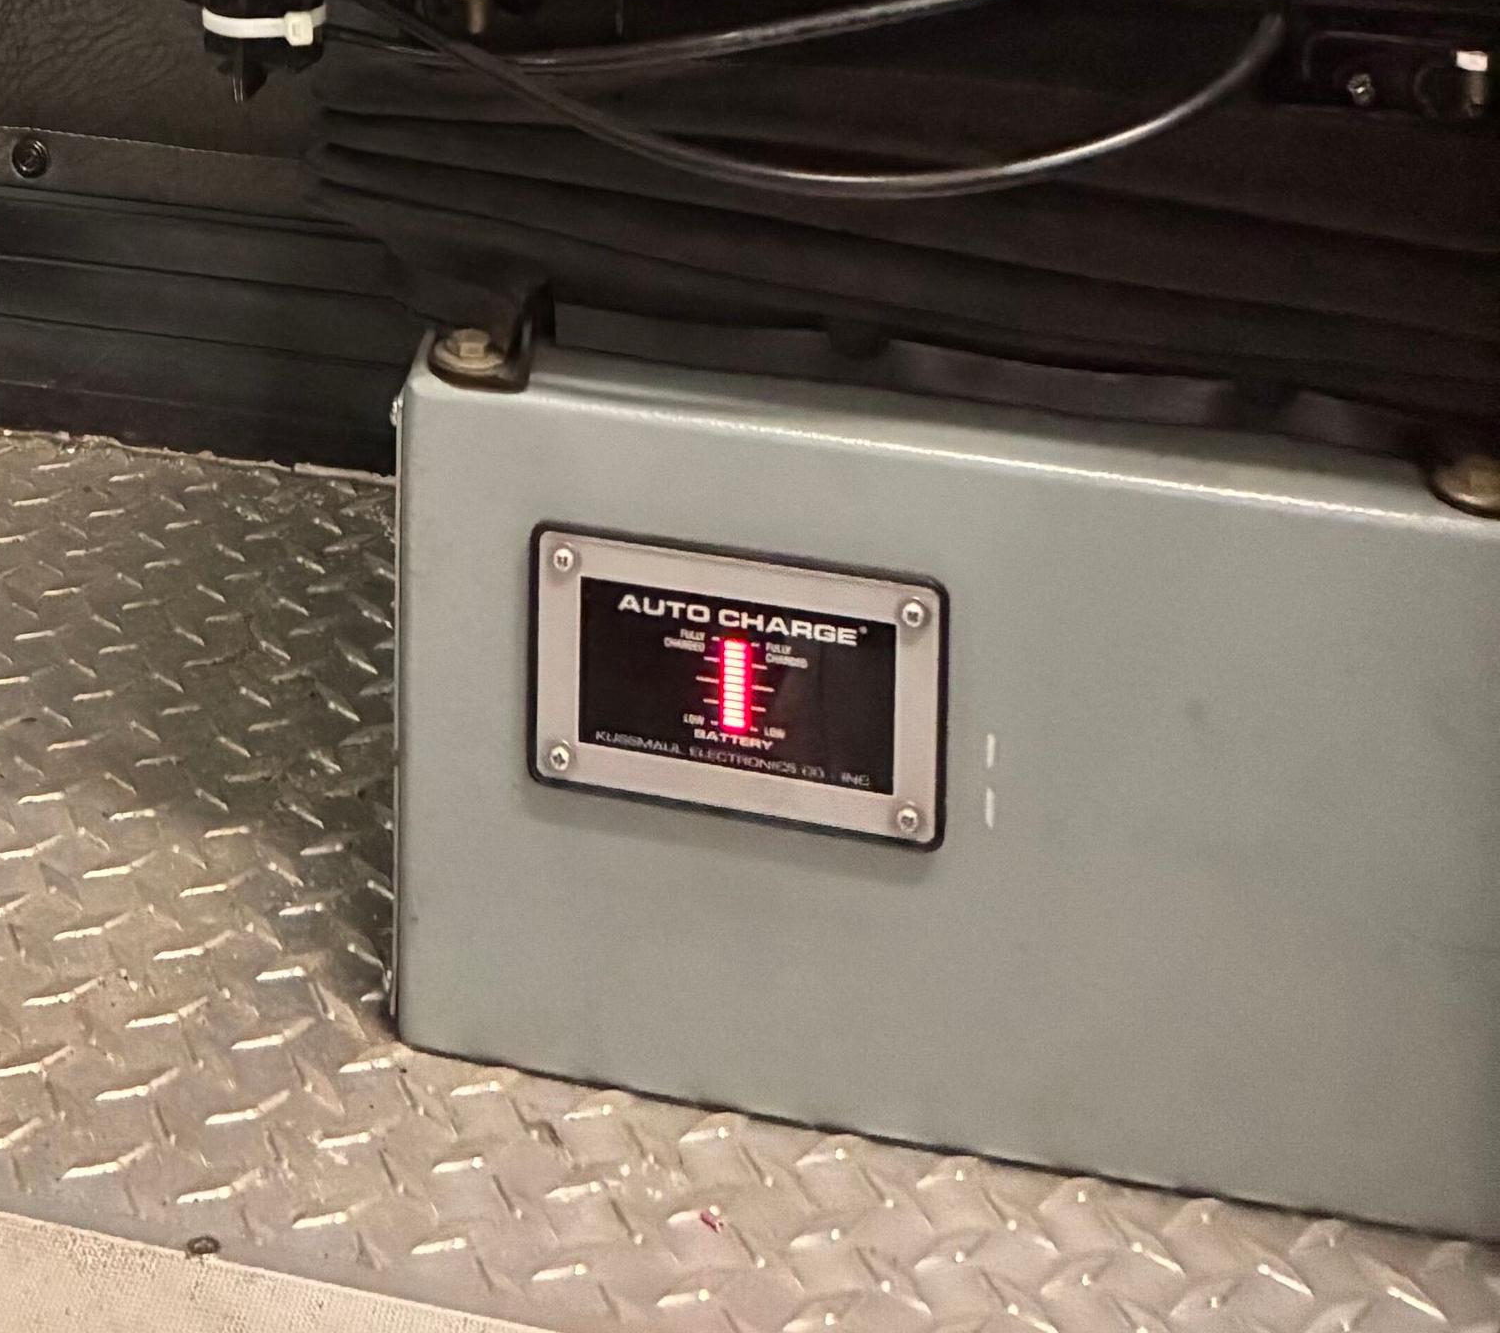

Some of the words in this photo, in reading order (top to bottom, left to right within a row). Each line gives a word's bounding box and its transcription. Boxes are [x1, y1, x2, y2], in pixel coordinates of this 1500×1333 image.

[618, 594, 711, 623] AUTO
[680, 628, 706, 642] FULLY
[664, 636, 706, 653] CHARGED
[765, 643, 792, 655] FULLY
[765, 653, 808, 669] CHARGED
[683, 713, 705, 726] LOW
[693, 728, 774, 751] BATTERY
[763, 726, 786, 740] LOW
[689, 747, 798, 778] ELECTRONICS
